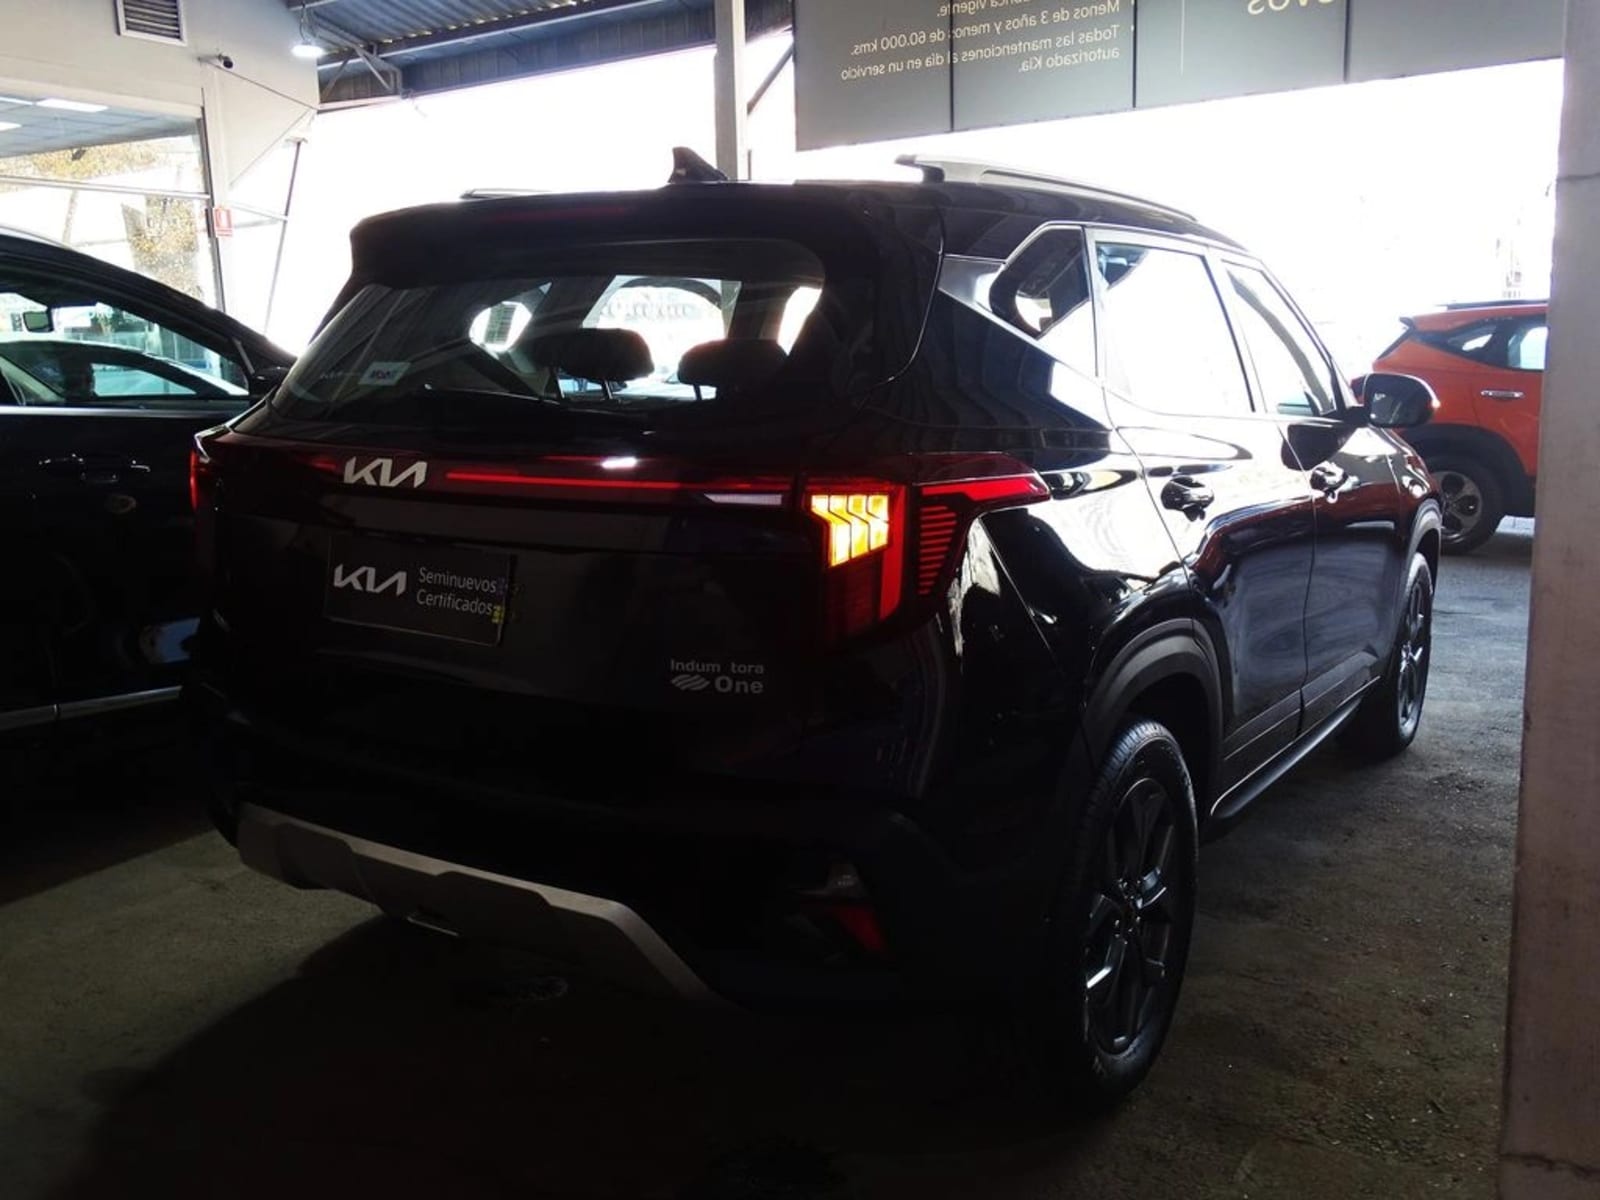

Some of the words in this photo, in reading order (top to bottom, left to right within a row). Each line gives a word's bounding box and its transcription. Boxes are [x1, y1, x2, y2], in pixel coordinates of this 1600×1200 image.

[343, 456, 428, 489] KIA
[333, 563, 408, 597] KIA
[419, 566, 498, 594] Seminuevos
[416, 588, 494, 615] Certificados
[714, 675, 764, 694] One
